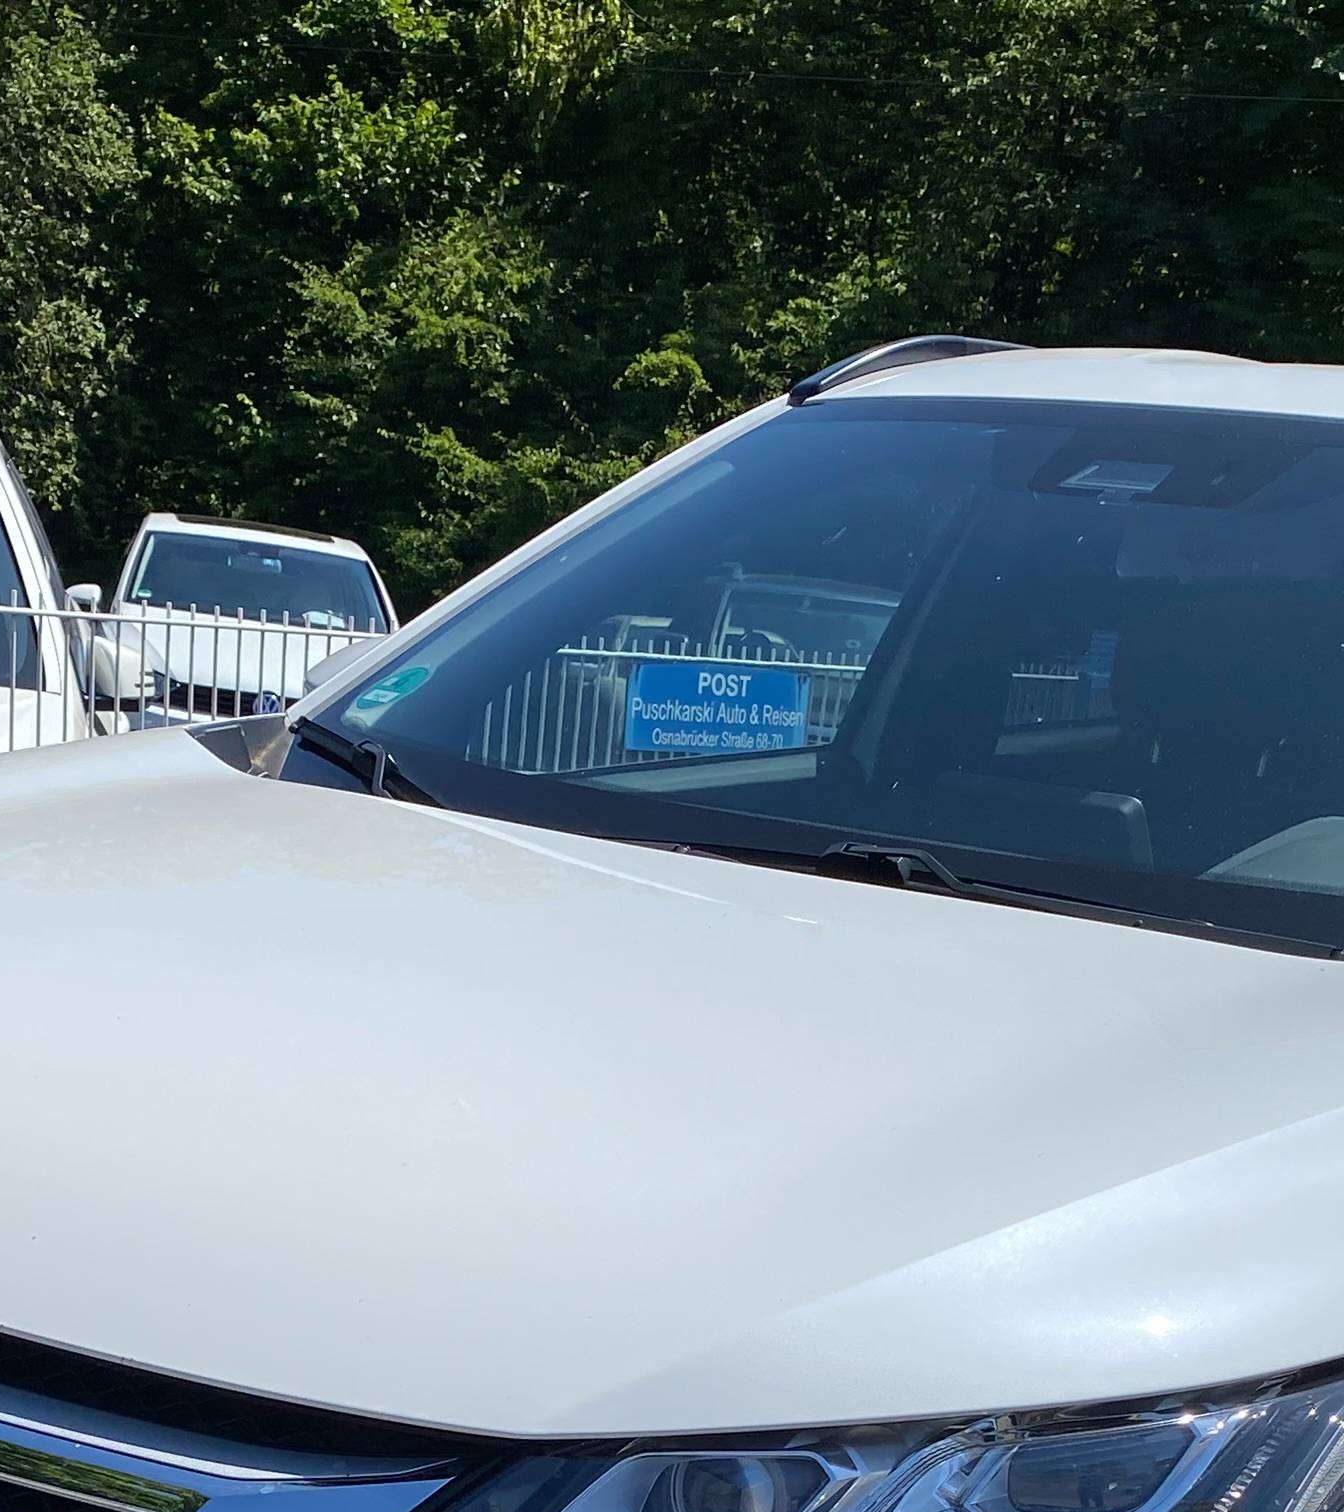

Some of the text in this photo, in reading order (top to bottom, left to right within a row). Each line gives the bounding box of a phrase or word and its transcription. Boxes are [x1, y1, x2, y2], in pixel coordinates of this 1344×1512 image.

[698, 672, 751, 698] POST
[631, 697, 803, 727] Puschkarski Auto & Reisen
[652, 727, 784, 749] Osnabrücker Straße 68-70
